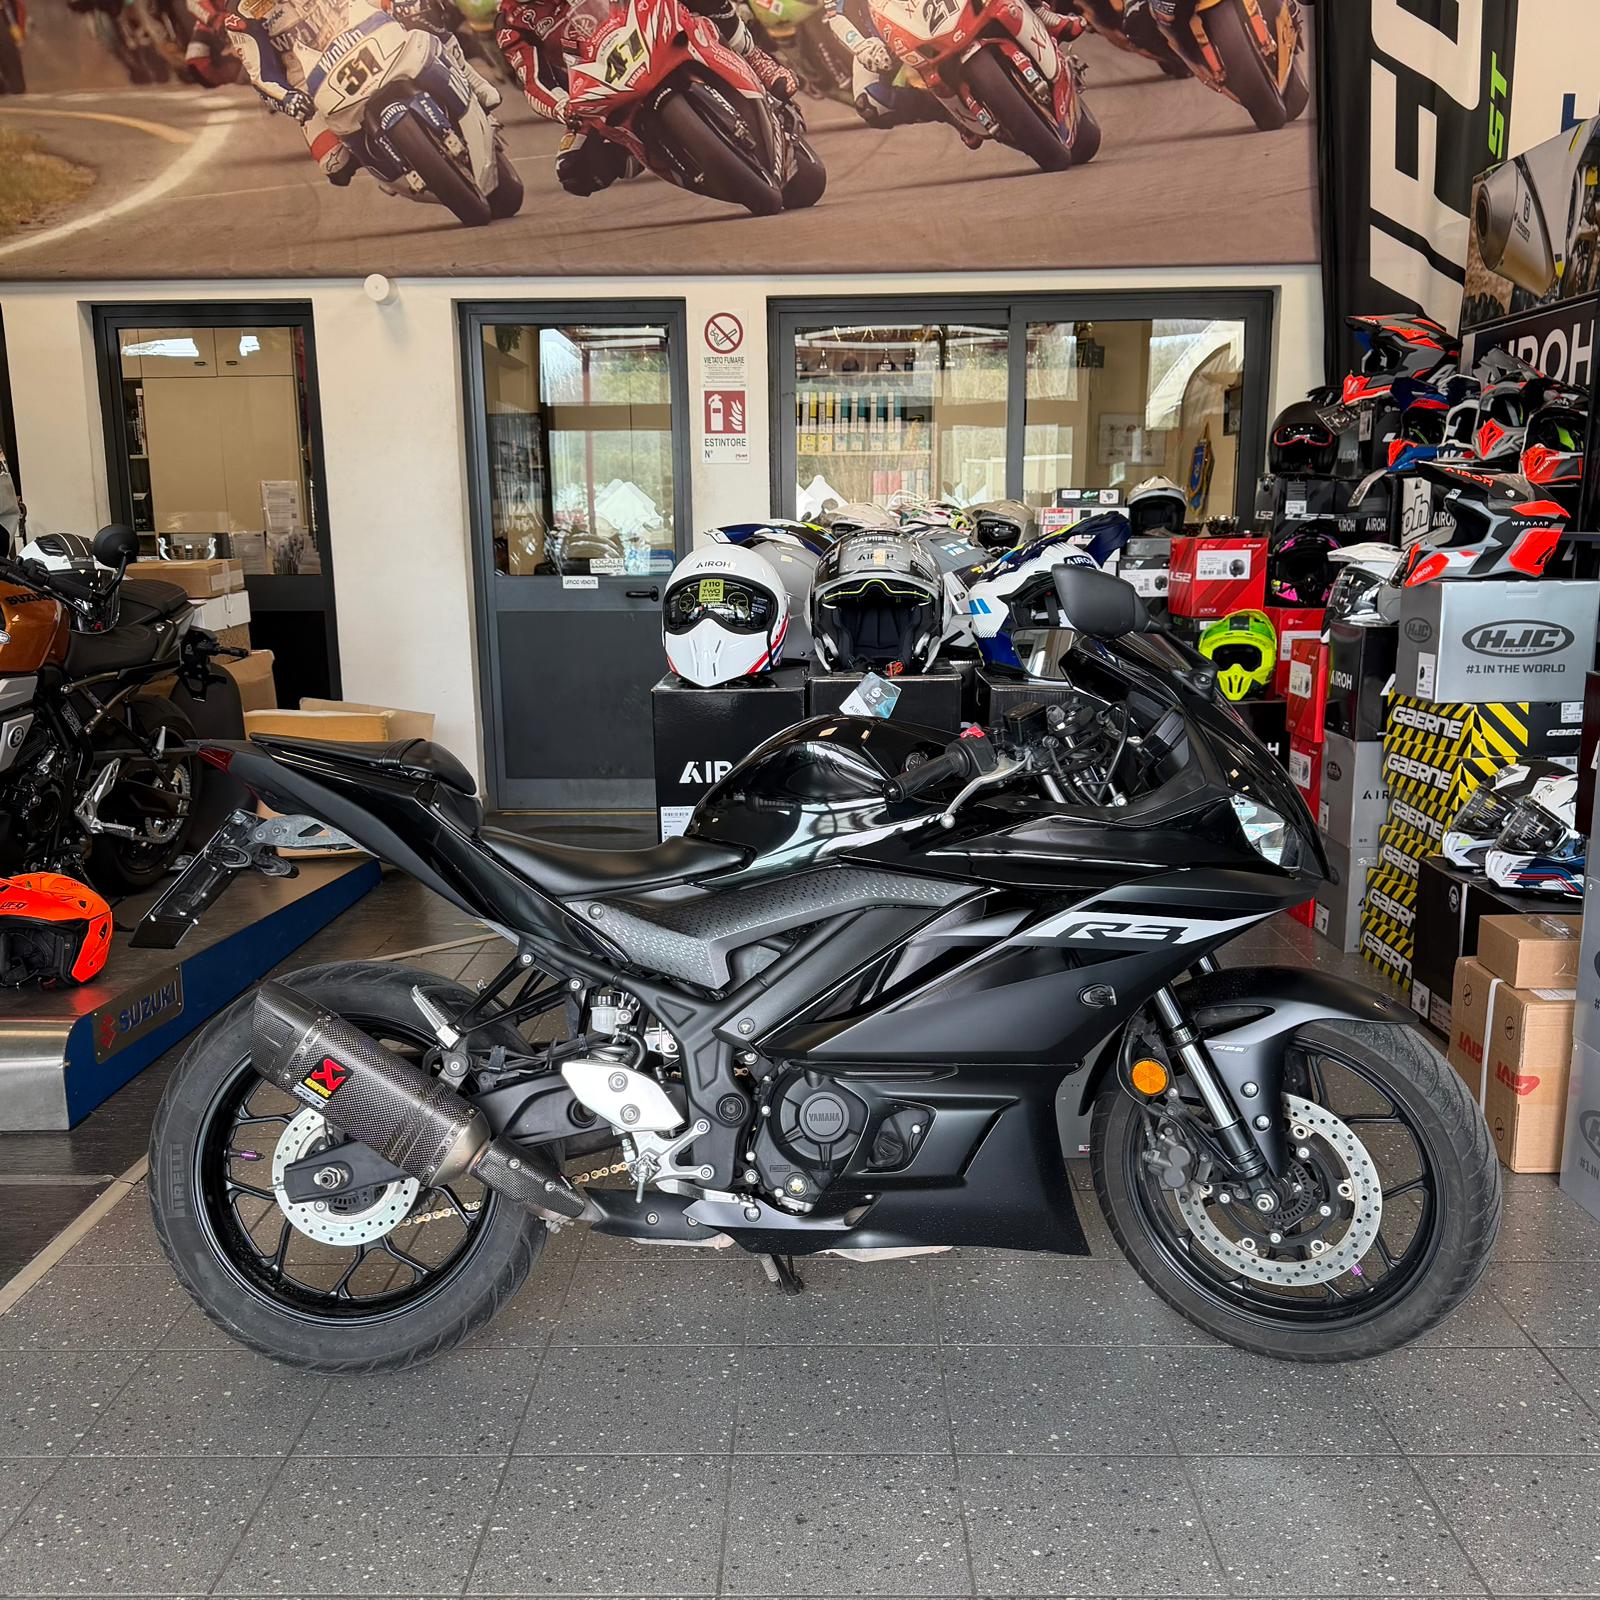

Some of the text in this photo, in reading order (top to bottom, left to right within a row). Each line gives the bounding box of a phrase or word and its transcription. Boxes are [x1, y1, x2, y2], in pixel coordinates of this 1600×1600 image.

[318, 27, 365, 74] WinWin
[605, 28, 646, 84] 41
[336, 46, 384, 96] 31
[704, 438, 746, 447] ESTINTORE
[1444, 467, 1494, 488] AIROH
[1255, 510, 1274, 520] LS2
[1366, 518, 1387, 532] AIROH
[696, 560, 731, 568] AIROH
[1411, 565, 1434, 583] AIROH
[1170, 571, 1192, 583] LS2
[1407, 622, 1429, 638] HJC
[1476, 630, 1562, 649] HJC
[1466, 663, 1566, 674] #1 IN THE WORLD
[1330, 670, 1353, 690] AIROH
[1391, 705, 1464, 740] GAERNE
[679, 761, 734, 784] AIR
[1386, 752, 1452, 791] GAERNE
[1362, 790, 1390, 800] AIR
[1391, 798, 1444, 842] GAERNE
[1383, 843, 1420, 880] GAER
[1056, 921, 1189, 945] R3
[1363, 930, 1412, 980] GAERN
[119, 980, 178, 1033] SUZUKI
[808, 1113, 840, 1122] YAMAHA
